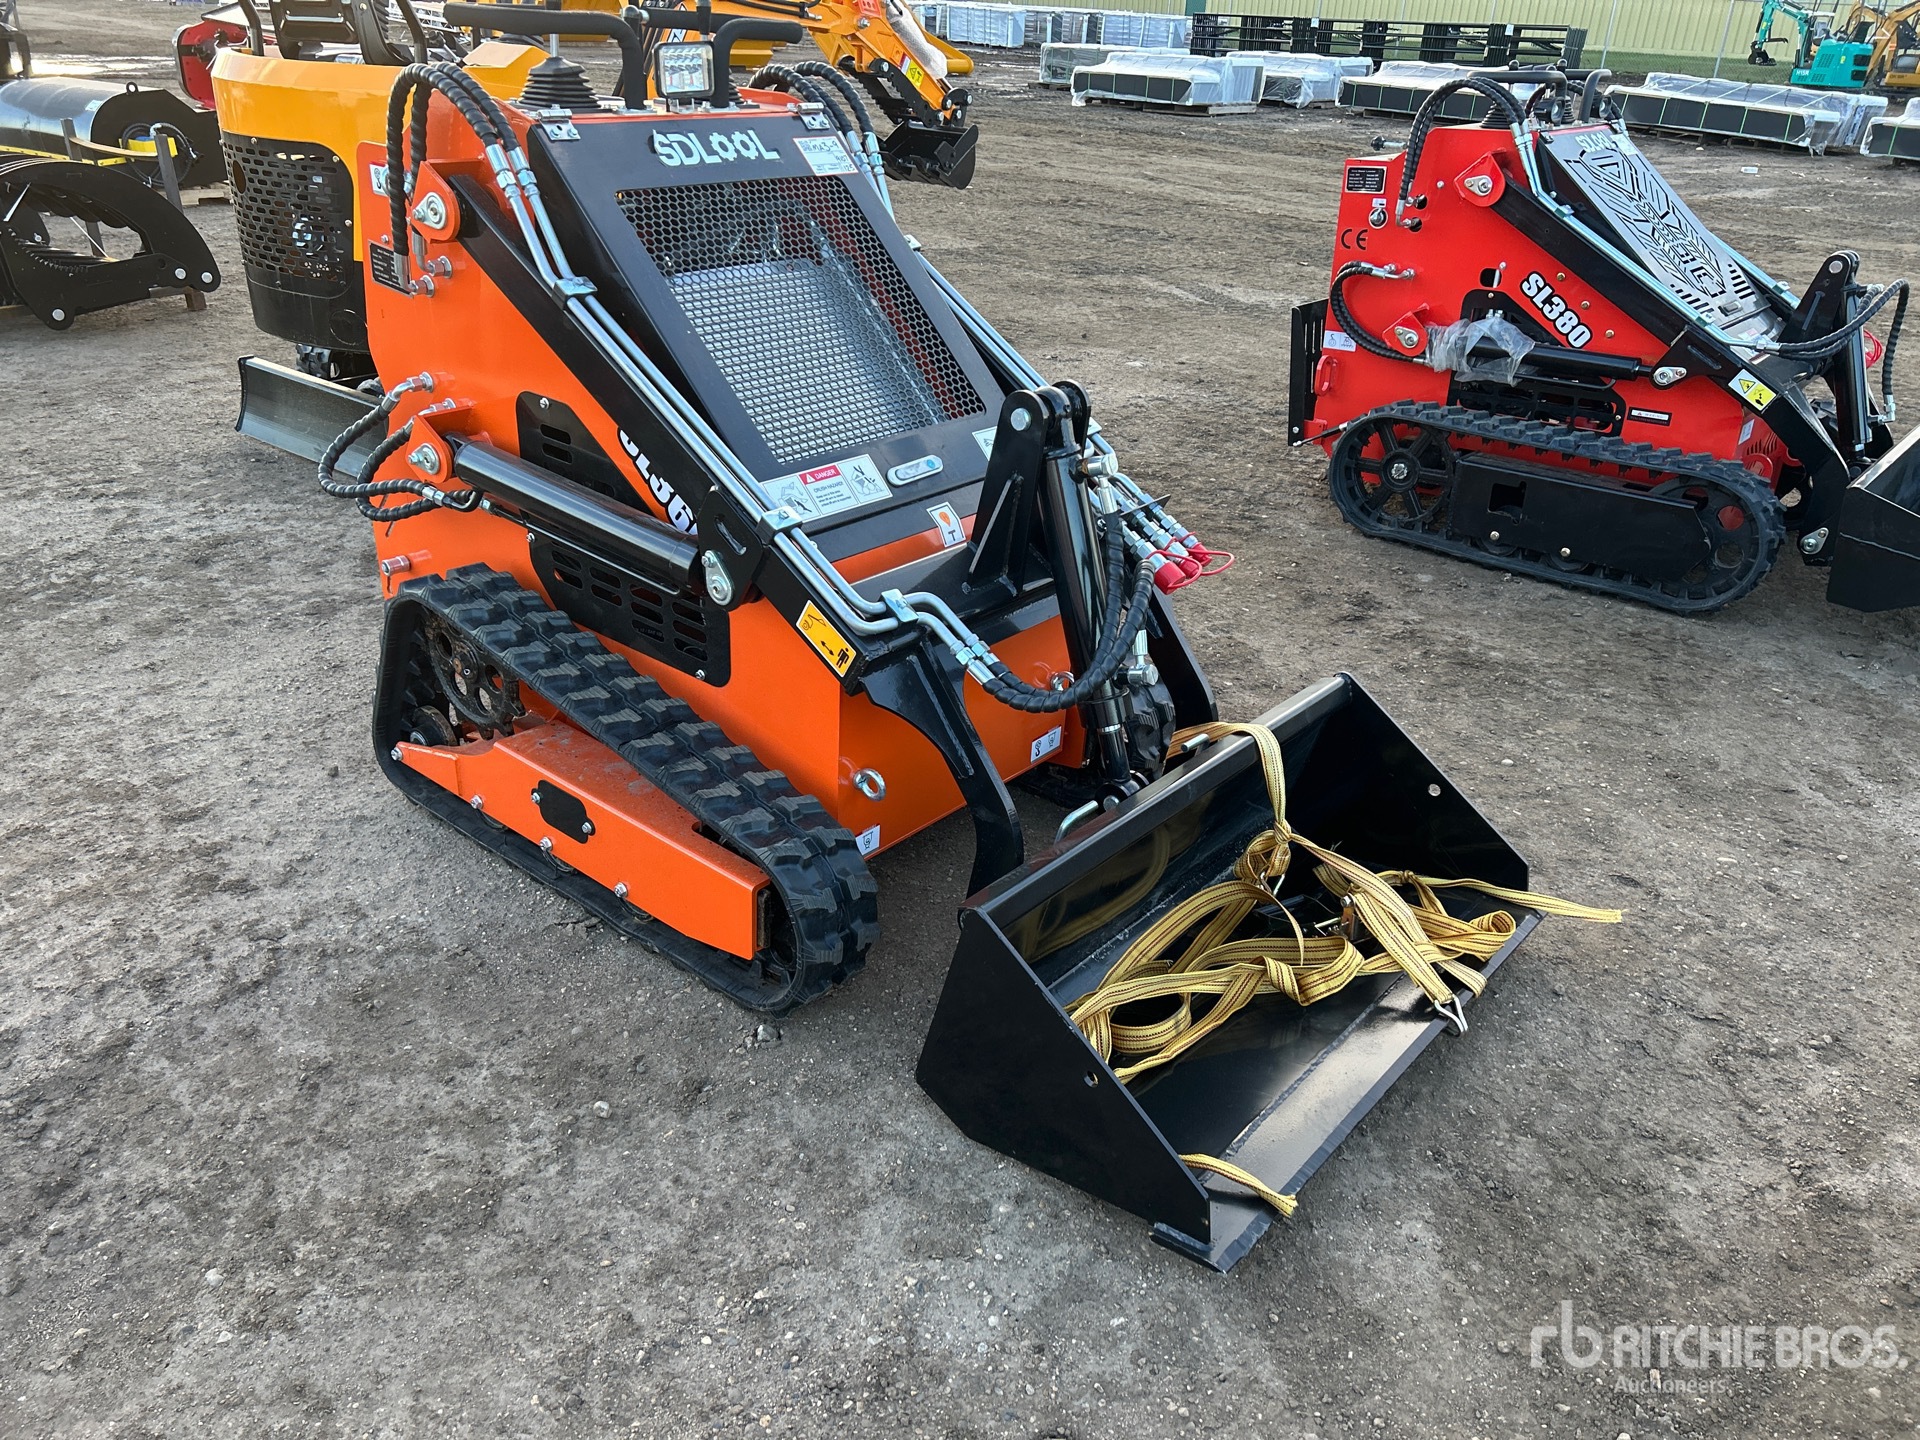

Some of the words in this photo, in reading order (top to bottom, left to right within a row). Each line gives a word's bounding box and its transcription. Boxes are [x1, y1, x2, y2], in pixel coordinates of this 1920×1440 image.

[1521, 271, 1592, 348] SL380
[619, 429, 698, 536] L36
[815, 469, 836, 479] DANGER
